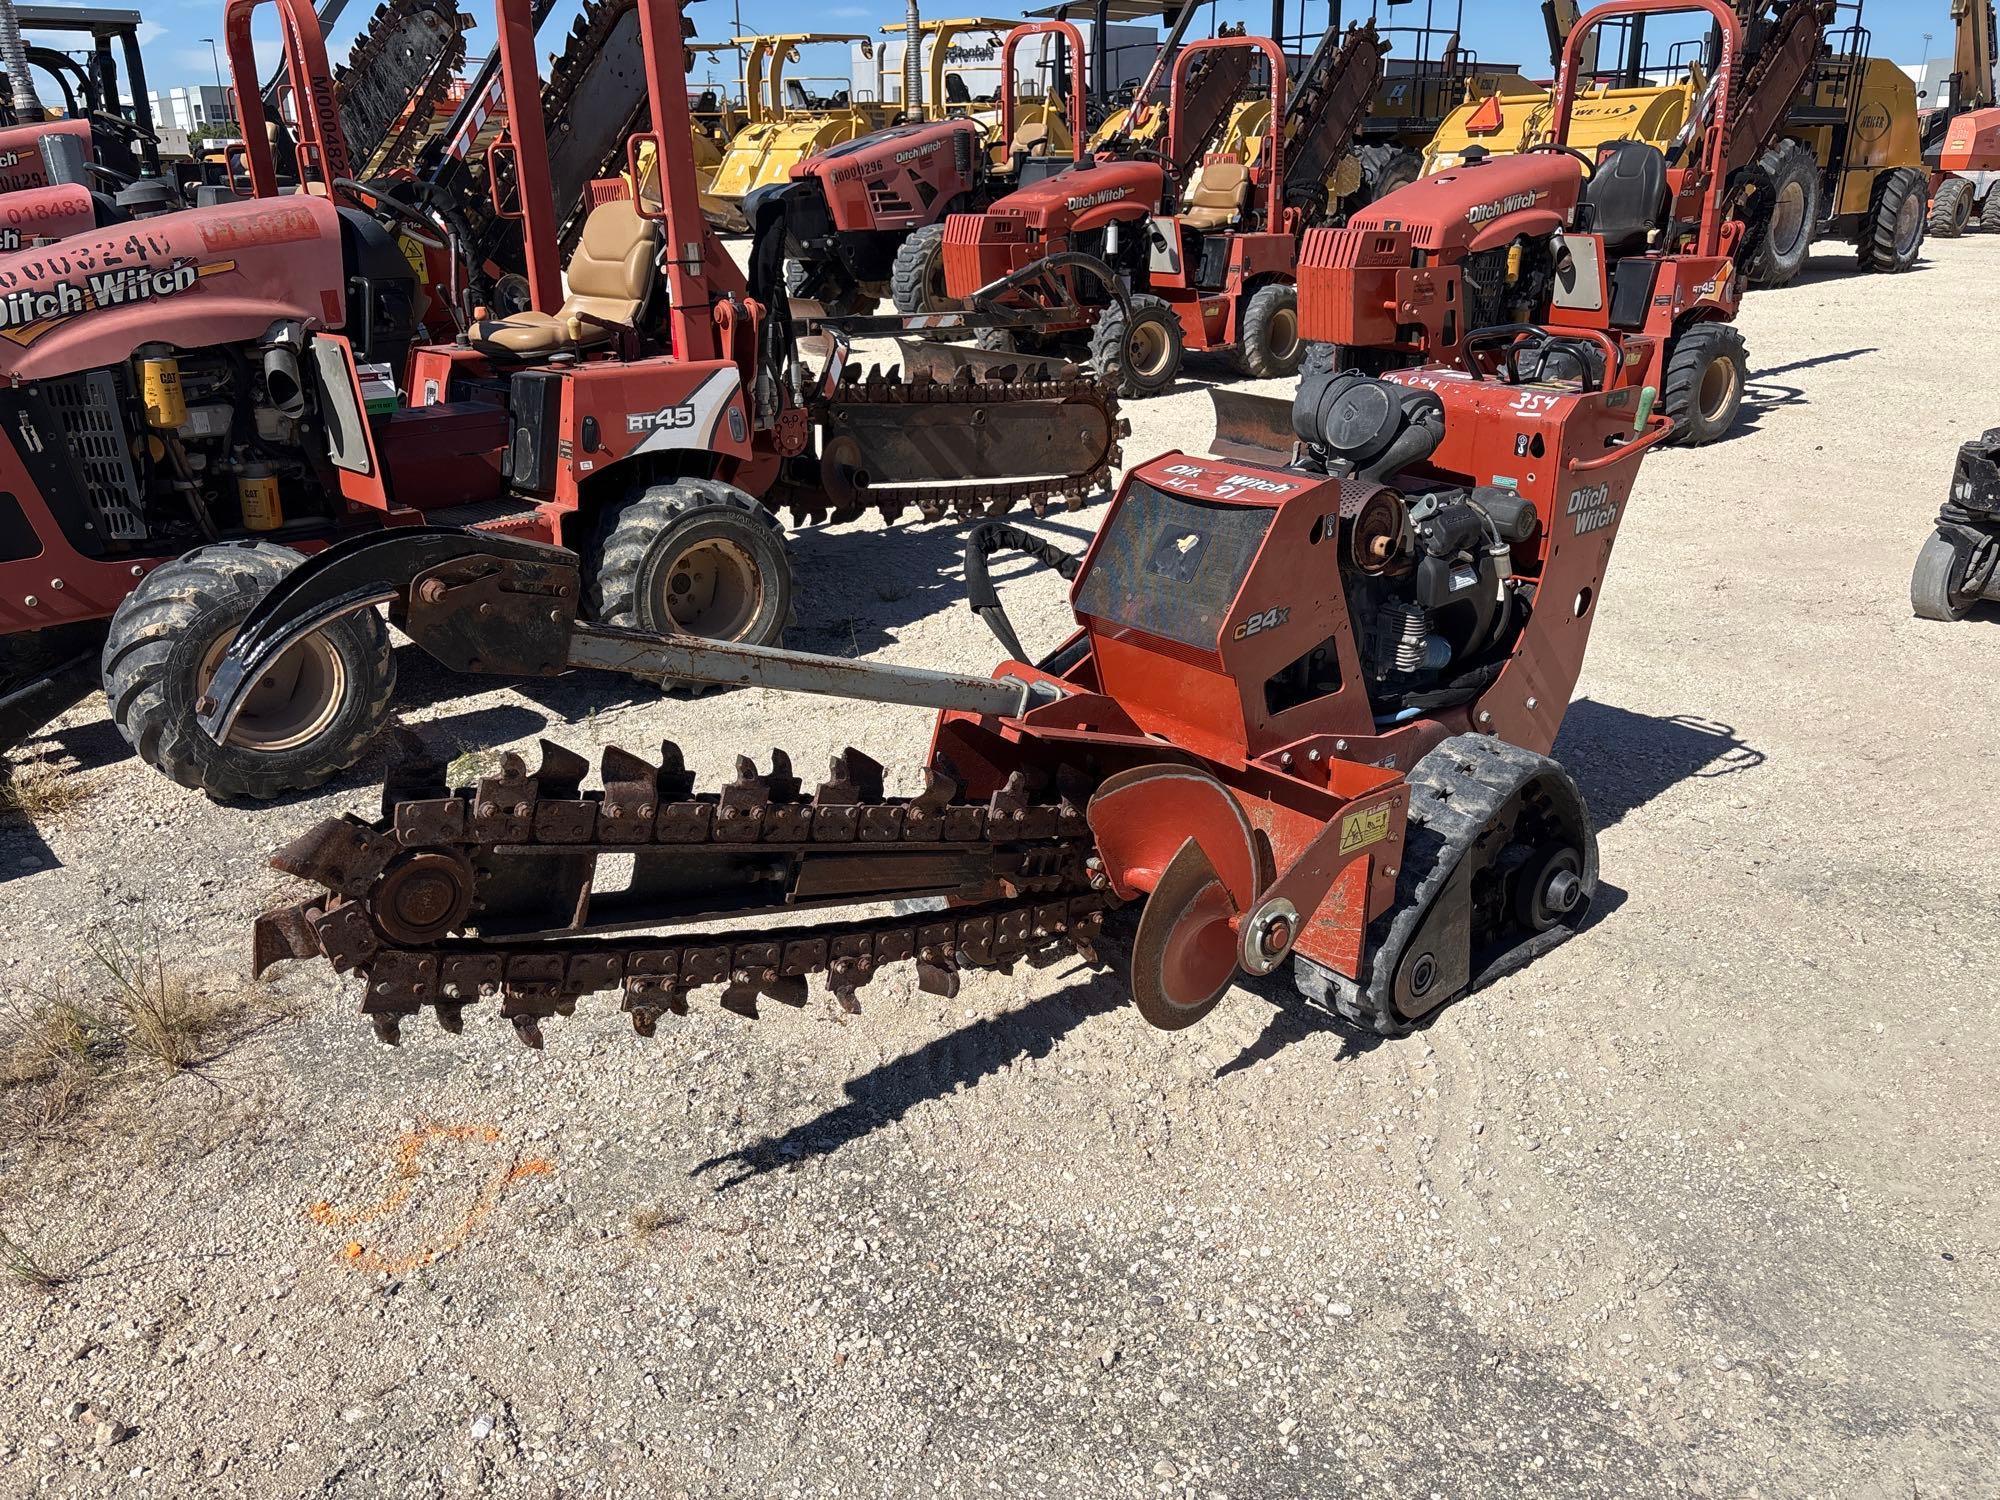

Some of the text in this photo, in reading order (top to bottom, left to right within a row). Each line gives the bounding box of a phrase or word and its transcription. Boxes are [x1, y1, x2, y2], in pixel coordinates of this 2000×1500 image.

[895, 141, 942, 163] Ditch Witch
[1067, 186, 1125, 211] Ditch Witch
[1468, 189, 1536, 224] Ditch Witch
[7, 198, 90, 225] 018483
[90, 260, 198, 307] Witch
[1692, 281, 1715, 294] RT45
[160, 373, 176, 384] CAT
[1510, 392, 1561, 411] 354
[628, 406, 693, 431] RT45
[1212, 484, 1247, 499] 91
[1222, 473, 1292, 494] Witch
[1567, 483, 1609, 515] Ditch
[1575, 501, 1620, 536] Witch
